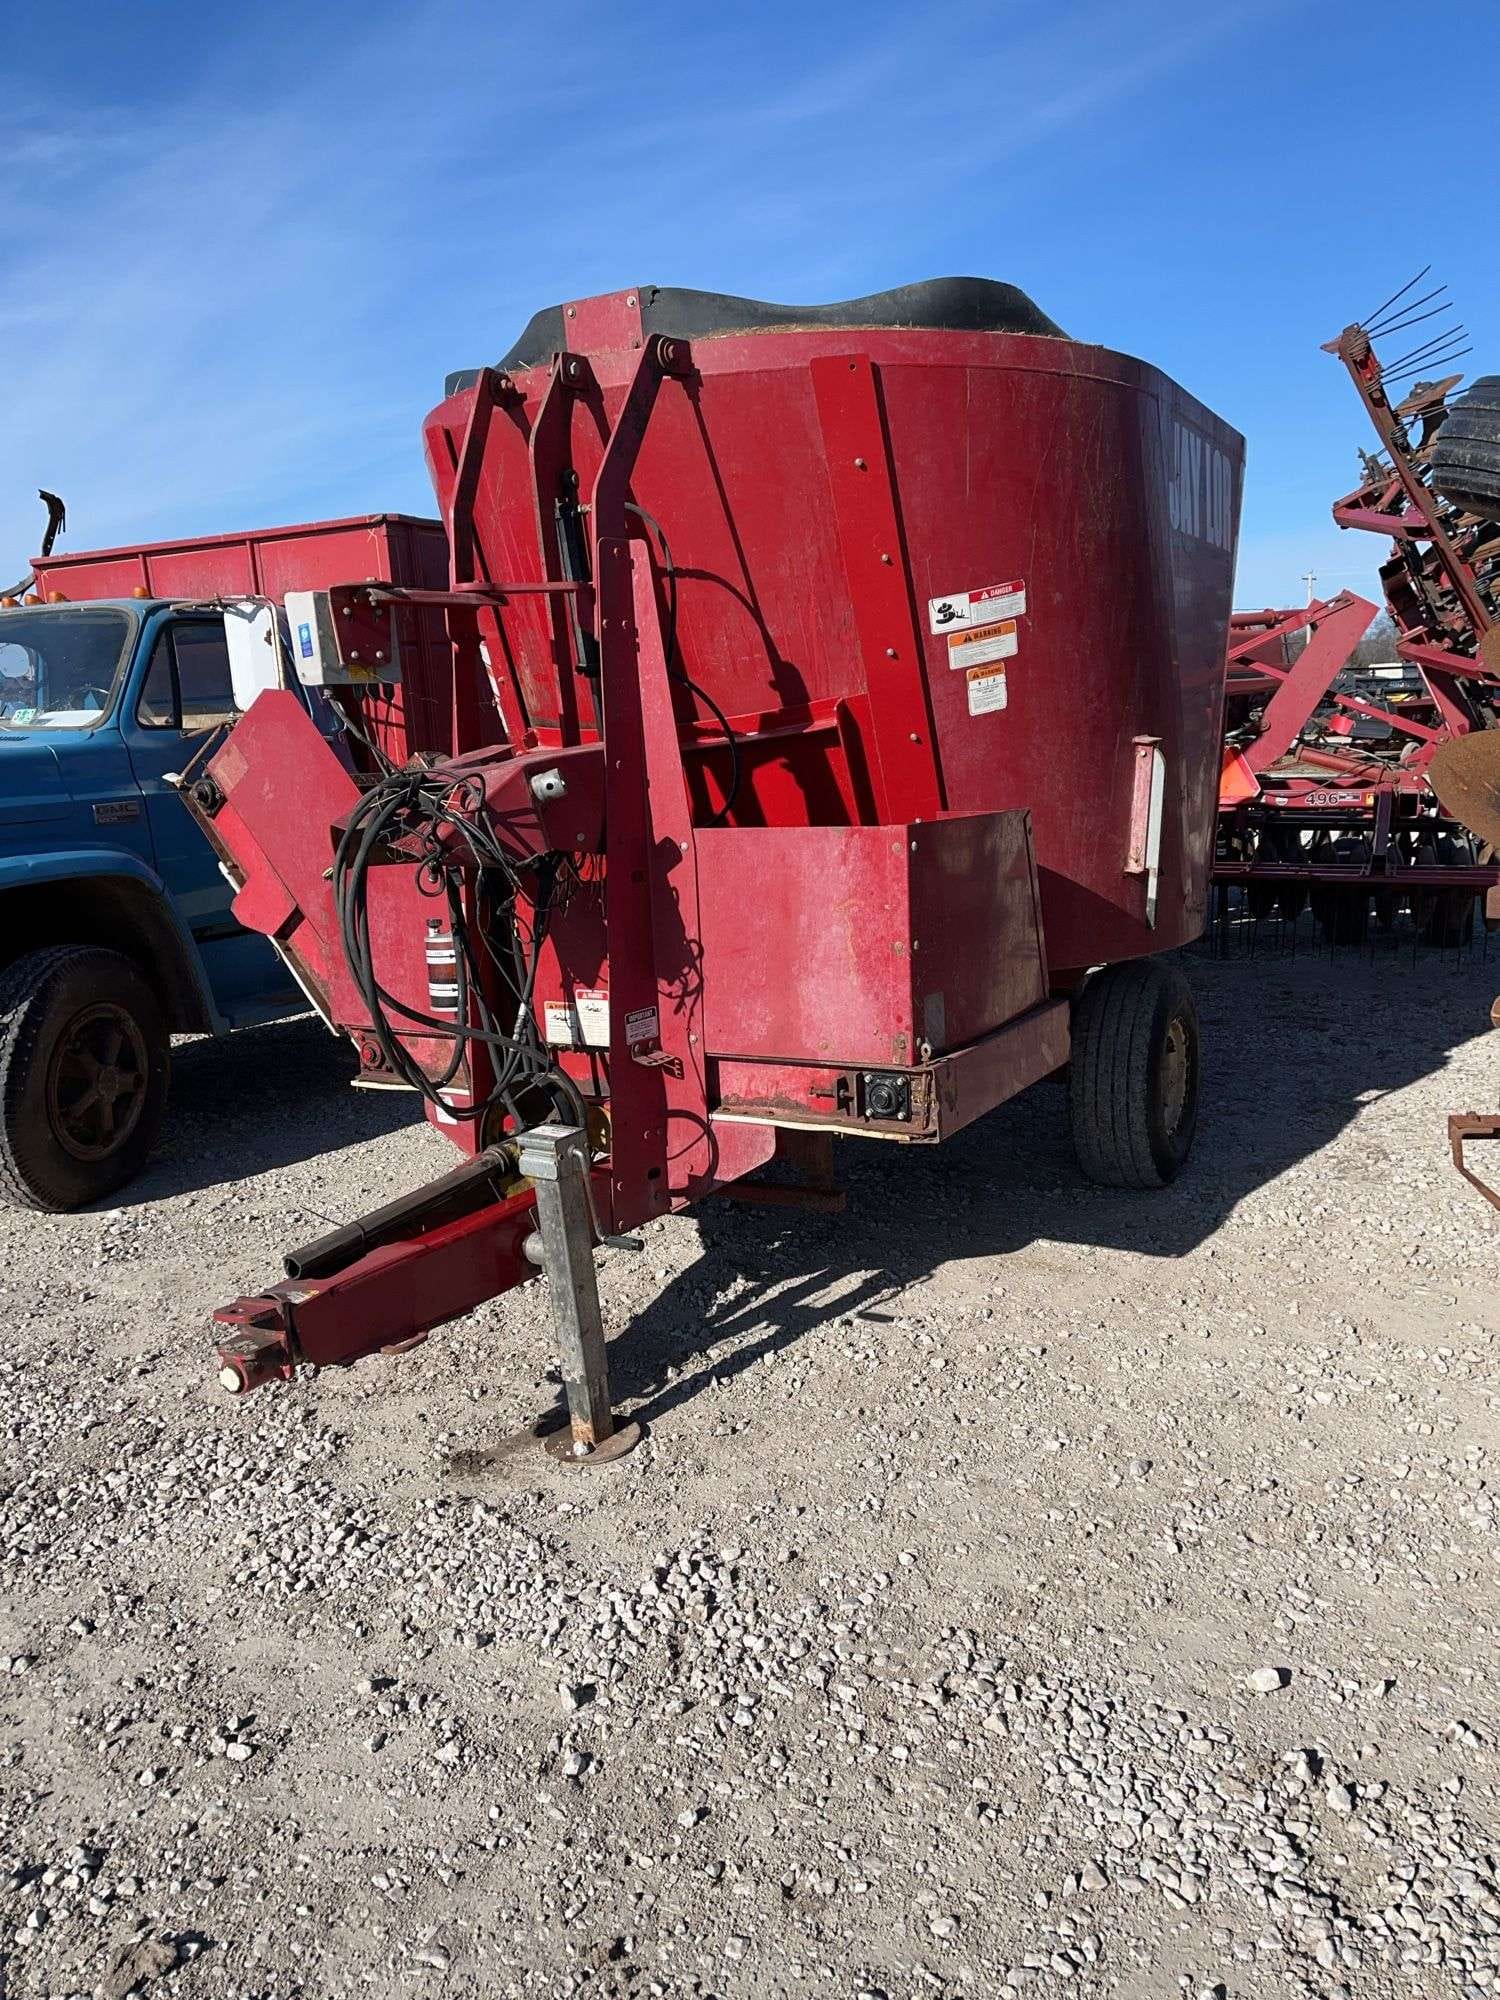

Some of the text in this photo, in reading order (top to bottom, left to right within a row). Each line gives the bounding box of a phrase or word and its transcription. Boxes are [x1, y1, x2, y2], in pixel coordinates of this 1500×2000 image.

[1169, 421, 1232, 553] JAYLOR
[990, 585, 1013, 597] DANGER
[973, 626, 1002, 640] WARNING
[980, 667, 1002, 676] WARNING
[1304, 792, 1339, 806] 496
